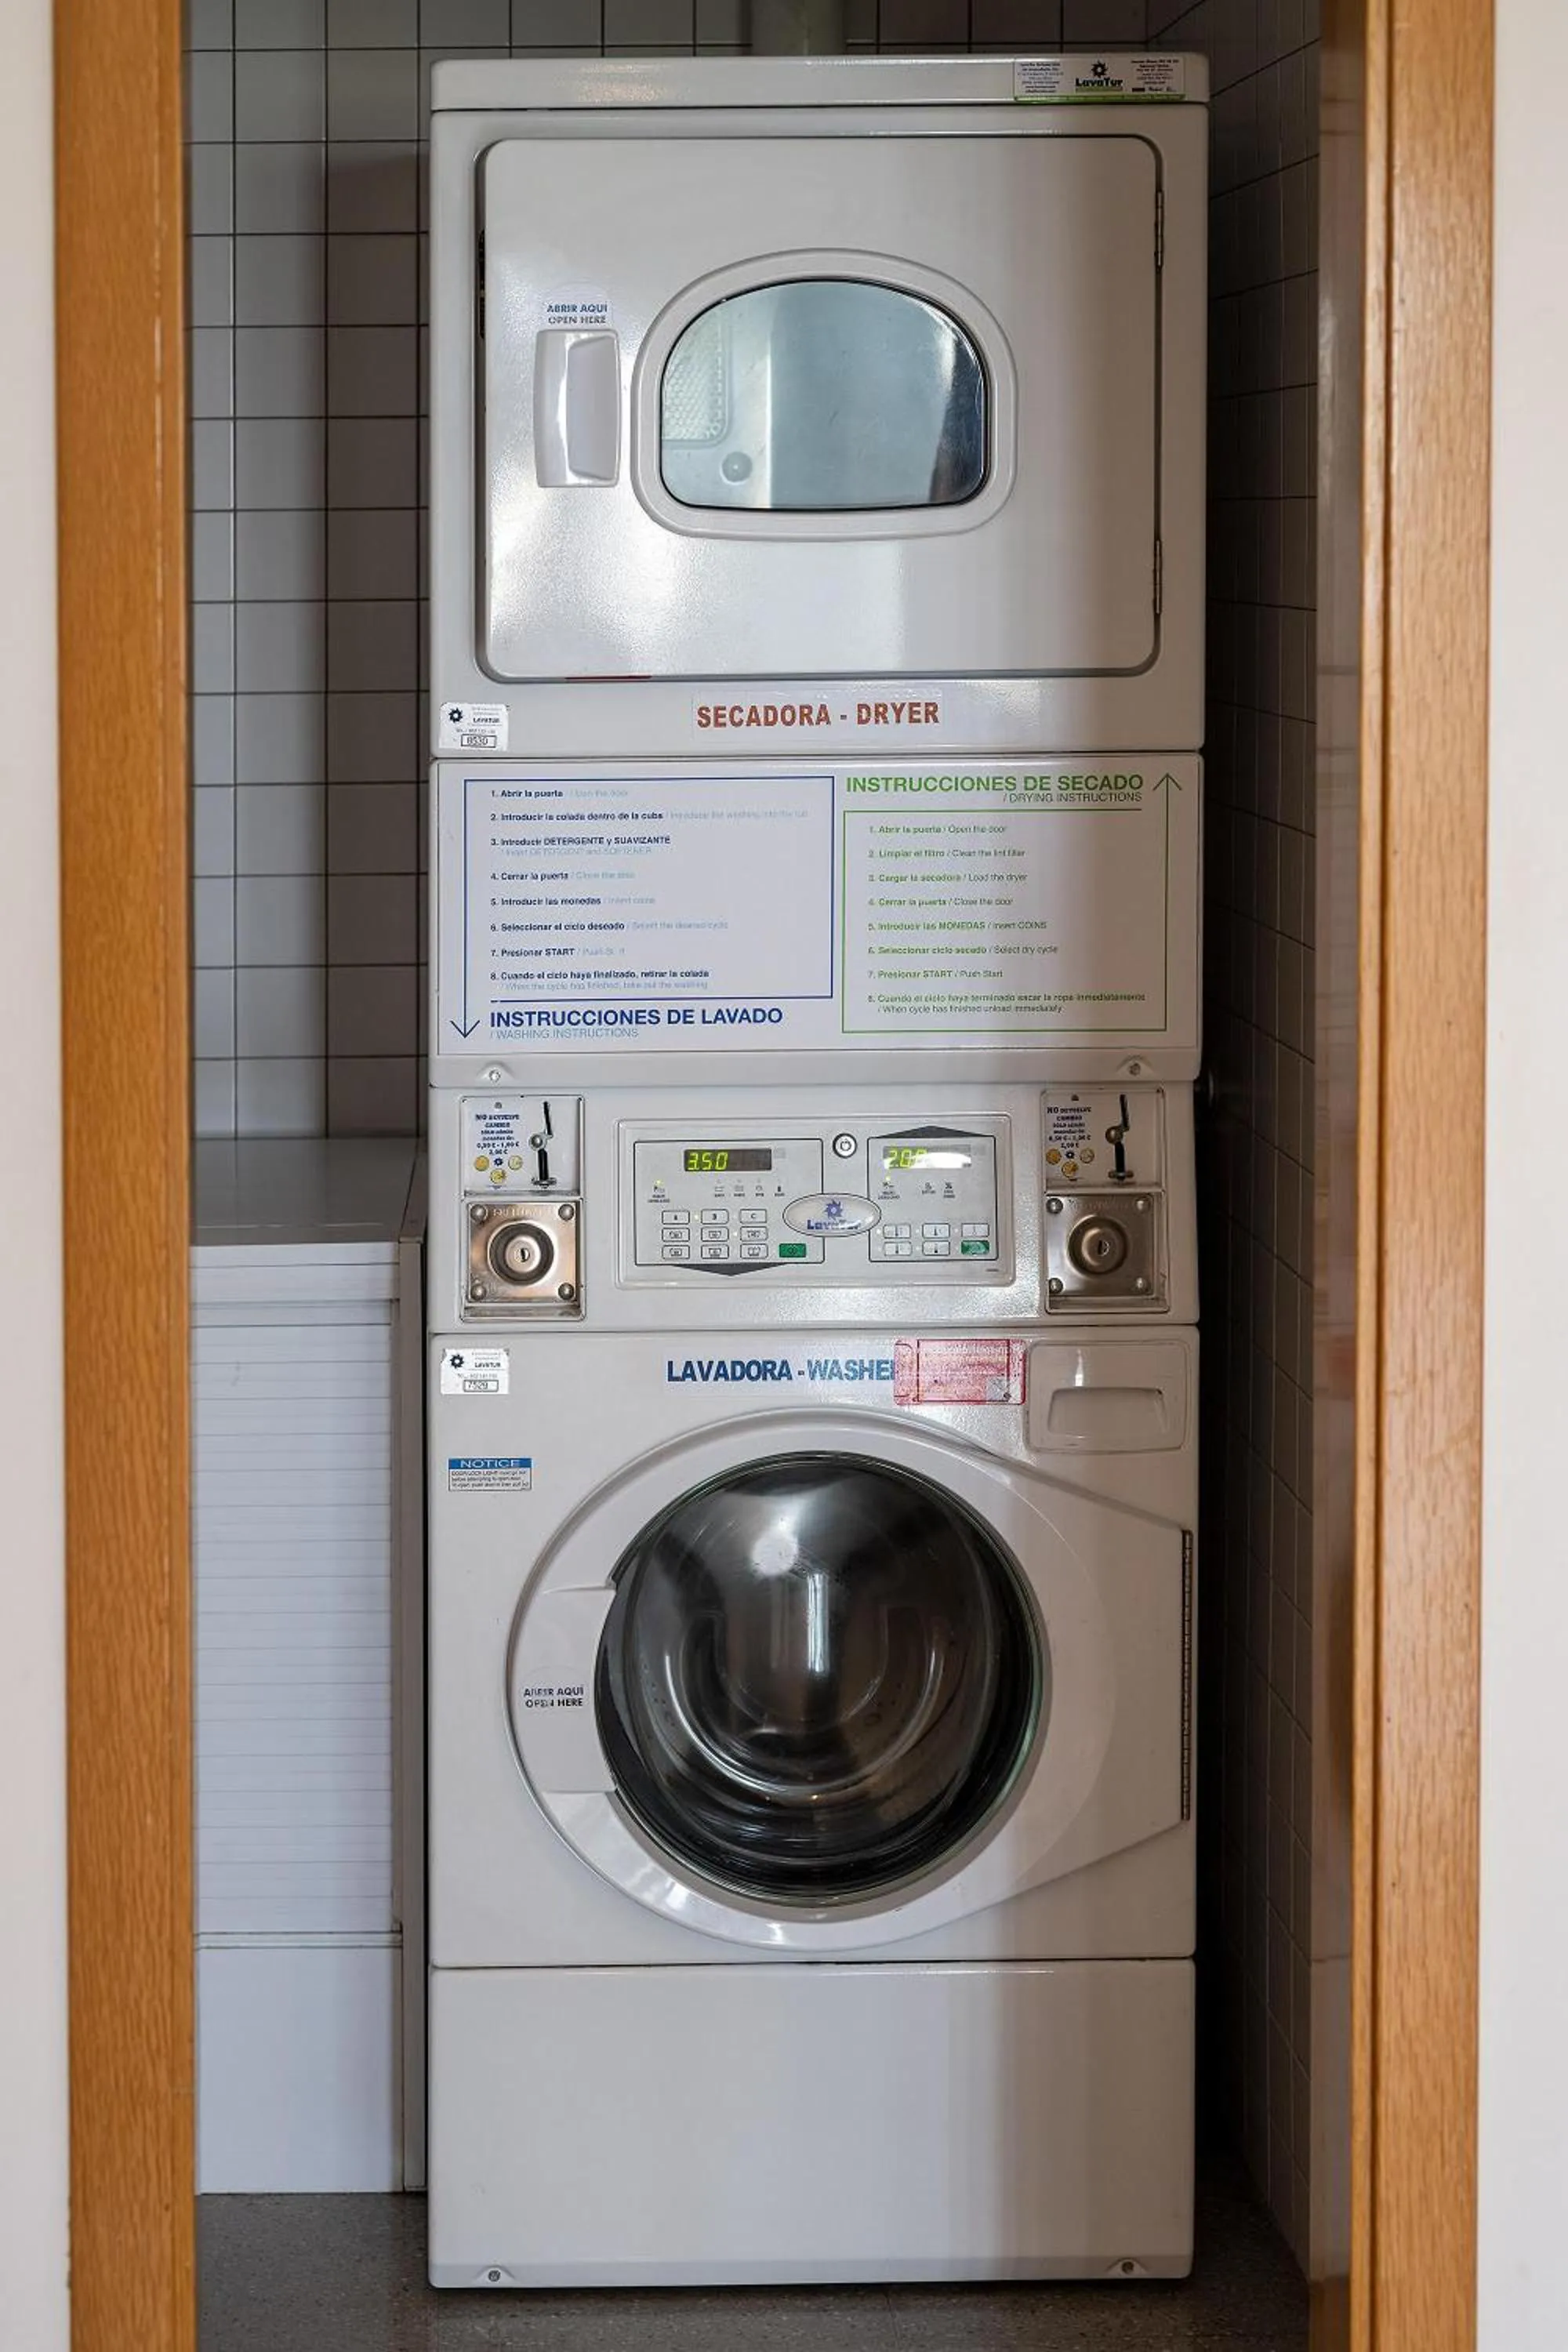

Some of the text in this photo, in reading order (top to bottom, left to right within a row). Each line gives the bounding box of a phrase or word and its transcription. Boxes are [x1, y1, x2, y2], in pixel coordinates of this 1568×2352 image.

[1076, 78, 1123, 87] LavaTur
[698, 703, 831, 728] SECADORA
[857, 702, 939, 724] DRYER
[847, 775, 1143, 792] INSTRUCCIONES DE SECADO
[535, 789, 563, 799] puerta
[1009, 793, 1053, 803] DRYING
[1057, 792, 1142, 803] INSTRUCTIONS
[913, 826, 941, 834] puerta
[947, 826, 971, 834] Open
[879, 850, 913, 859] Limpiar
[540, 872, 569, 881] puerta
[879, 874, 908, 884] Cargar
[1005, 873, 1028, 883] dryer
[918, 898, 947, 907] puerta
[1022, 946, 1035, 955] dry
[1036, 946, 1058, 955] cycle
[570, 971, 591, 981] haya
[948, 994, 969, 1004] haya
[909, 1005, 931, 1014] cycle
[491, 1008, 782, 1027] INSTRUCCIONES DE LAVADO
[495, 1029, 549, 1039] WASHING
[553, 1029, 639, 1038] INSTRUCTIONS
[668, 1359, 792, 1381] LAVADORA
[524, 1688, 554, 1697] ABRIR
[525, 1699, 554, 1708] OPEN
